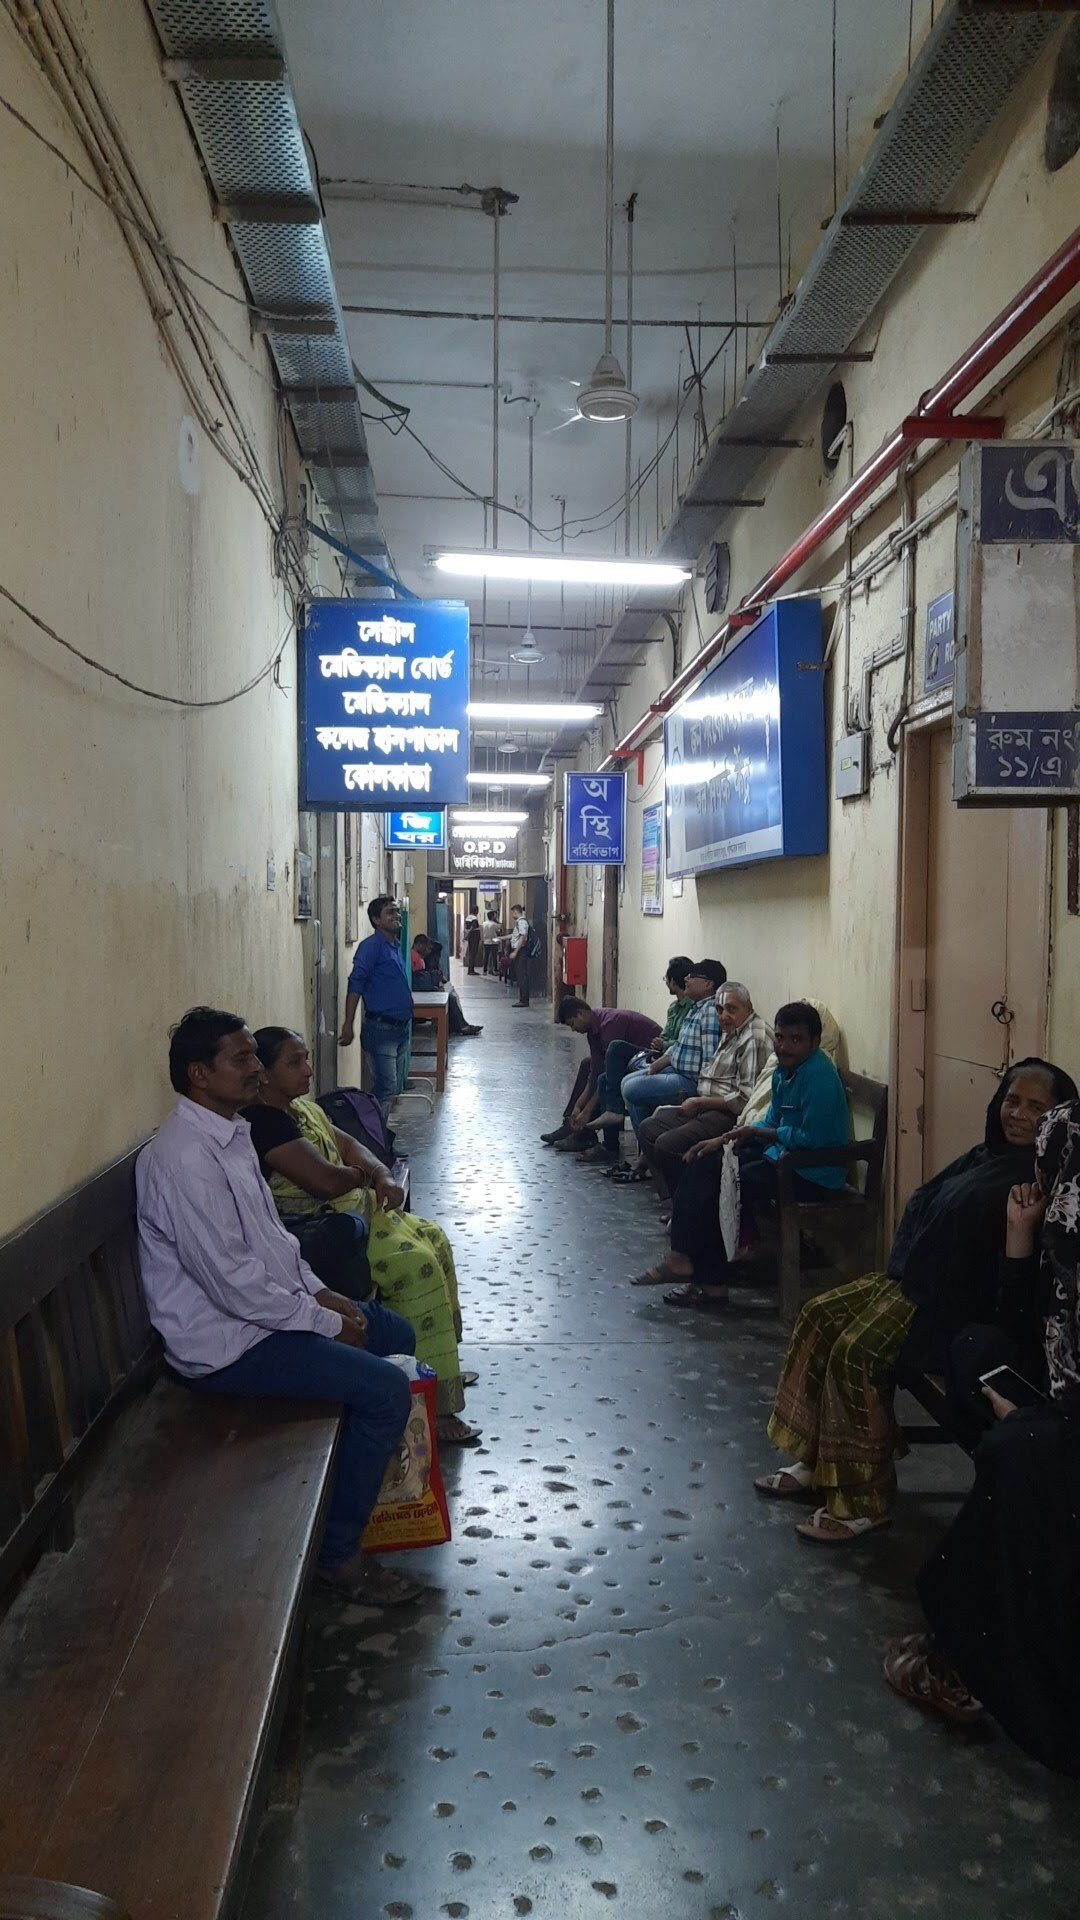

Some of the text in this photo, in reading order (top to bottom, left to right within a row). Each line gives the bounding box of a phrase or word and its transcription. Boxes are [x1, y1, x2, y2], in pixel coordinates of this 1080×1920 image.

[1004, 448, 1067, 523] এ
[929, 608, 952, 641] PARTY
[410, 649, 455, 680] বোর্ড
[314, 726, 371, 751] কলেজ
[986, 728, 1075, 752] রুম নং
[998, 755, 1061, 779] ১১/এ
[581, 778, 612, 802] অ
[463, 841, 506, 854] O.P.D
